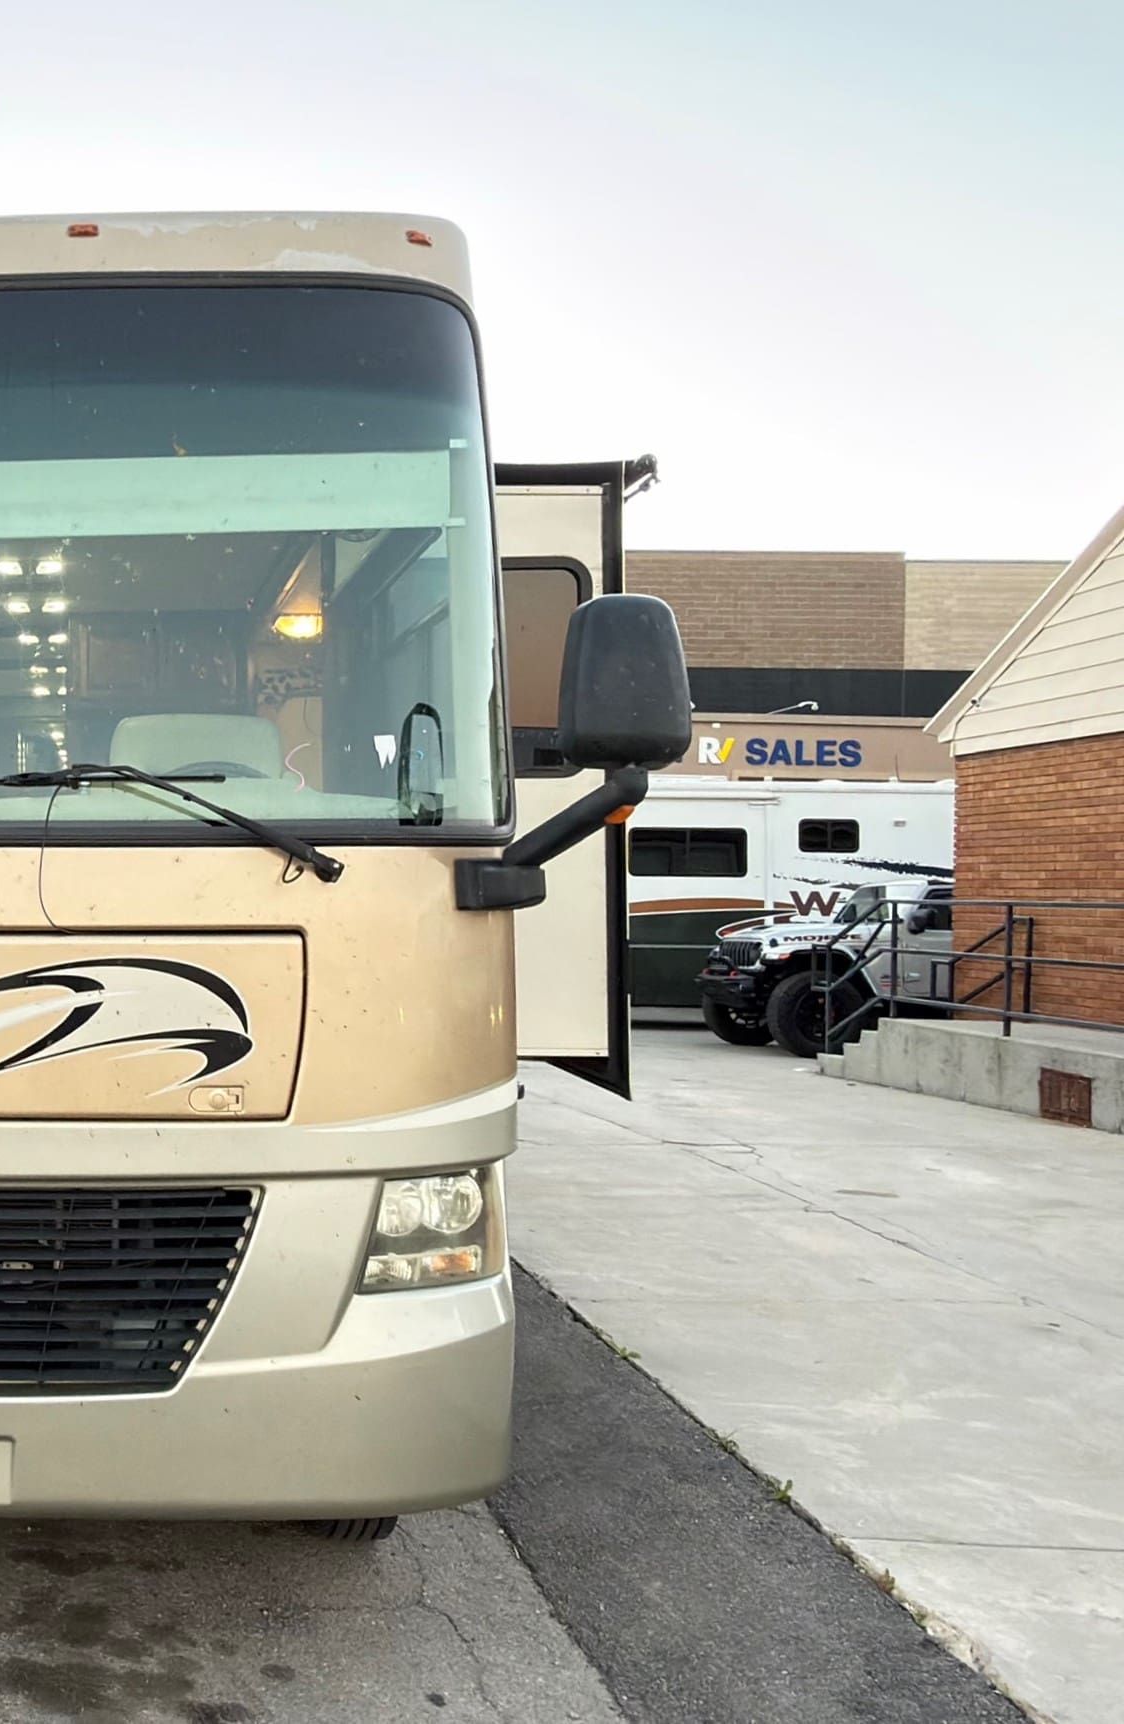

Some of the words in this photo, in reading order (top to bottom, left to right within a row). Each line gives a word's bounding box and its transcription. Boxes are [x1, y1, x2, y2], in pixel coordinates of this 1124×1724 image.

[697, 736, 736, 765] RV
[745, 738, 863, 768] SALES
[789, 890, 841, 917] W
